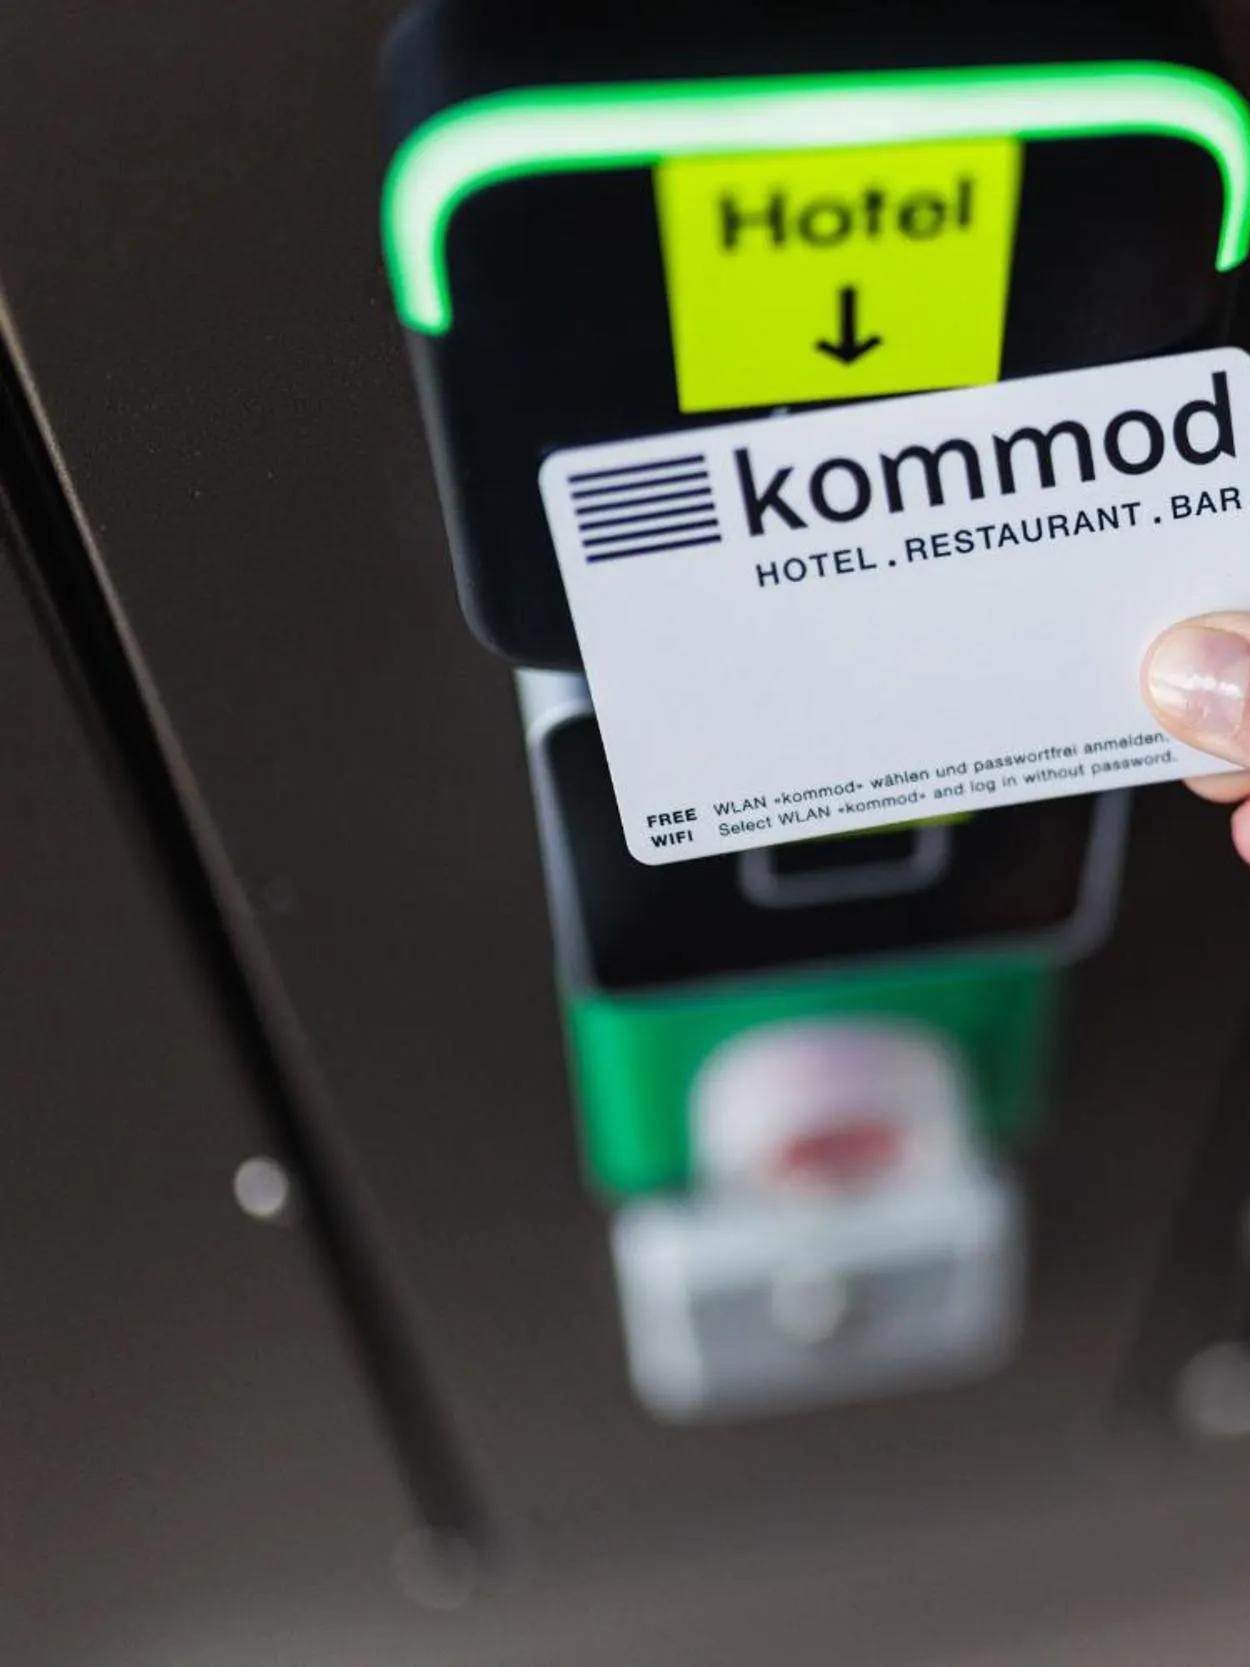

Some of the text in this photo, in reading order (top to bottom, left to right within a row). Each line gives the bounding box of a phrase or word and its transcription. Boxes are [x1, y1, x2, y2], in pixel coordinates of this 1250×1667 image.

[719, 172, 973, 254] Hotel
[734, 371, 1236, 536] kommod
[755, 546, 877, 587] HOTEL
[904, 502, 1141, 562] RESTAURANT
[1170, 487, 1243, 520] BAR
[647, 808, 698, 828] FREE
[713, 795, 767, 816] WLAN
[870, 769, 930, 790] wählen
[935, 762, 967, 779] und
[974, 746, 1077, 774] passwortfrei
[718, 817, 771, 837] Select
[778, 806, 831, 825] WLAN
[933, 784, 964, 799] and
[970, 779, 996, 793] log
[1002, 775, 1017, 788] in
[1023, 765, 1086, 784] without
[1091, 751, 1178, 776] password.
[650, 830, 694, 848] WIFI
